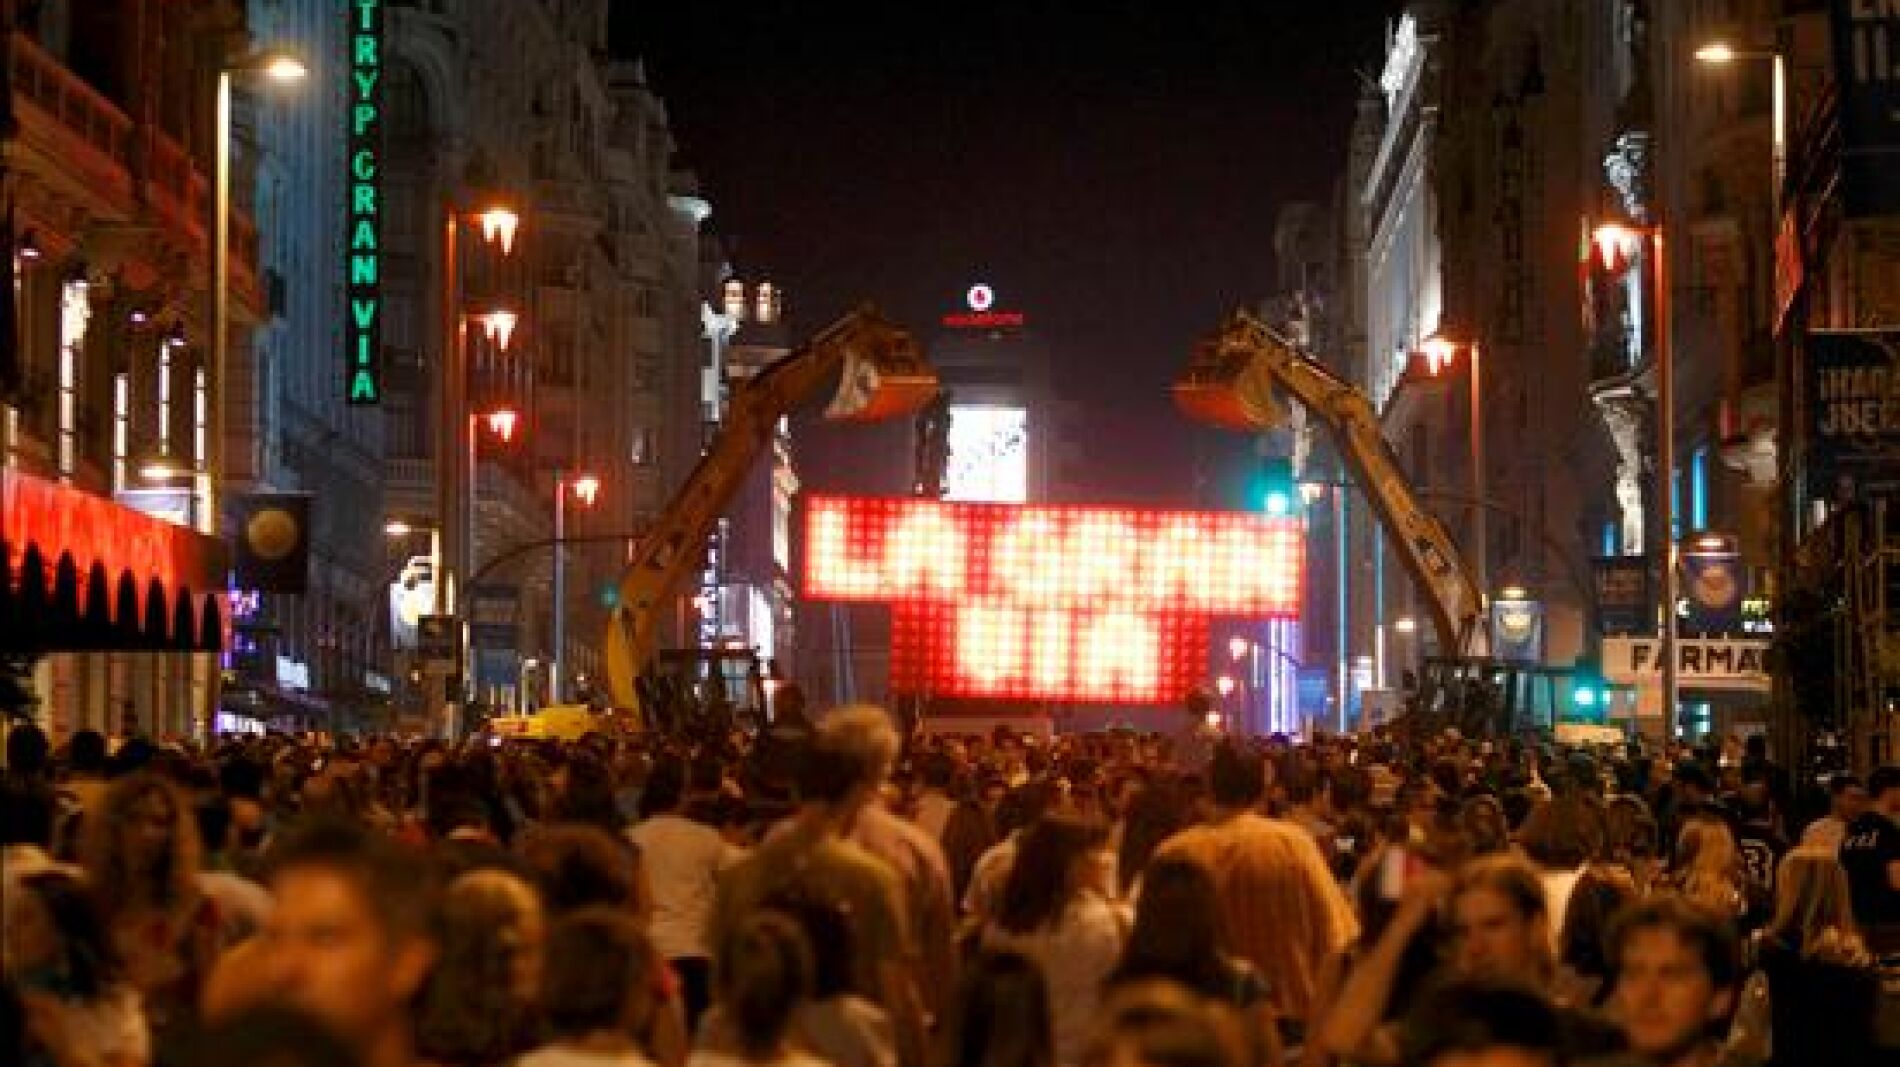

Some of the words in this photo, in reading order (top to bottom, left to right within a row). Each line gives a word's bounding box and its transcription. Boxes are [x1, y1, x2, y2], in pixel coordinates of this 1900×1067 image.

[353, 150, 377, 284] GRAN
[352, 300, 376, 398] VIA
[809, 500, 967, 600] LA
